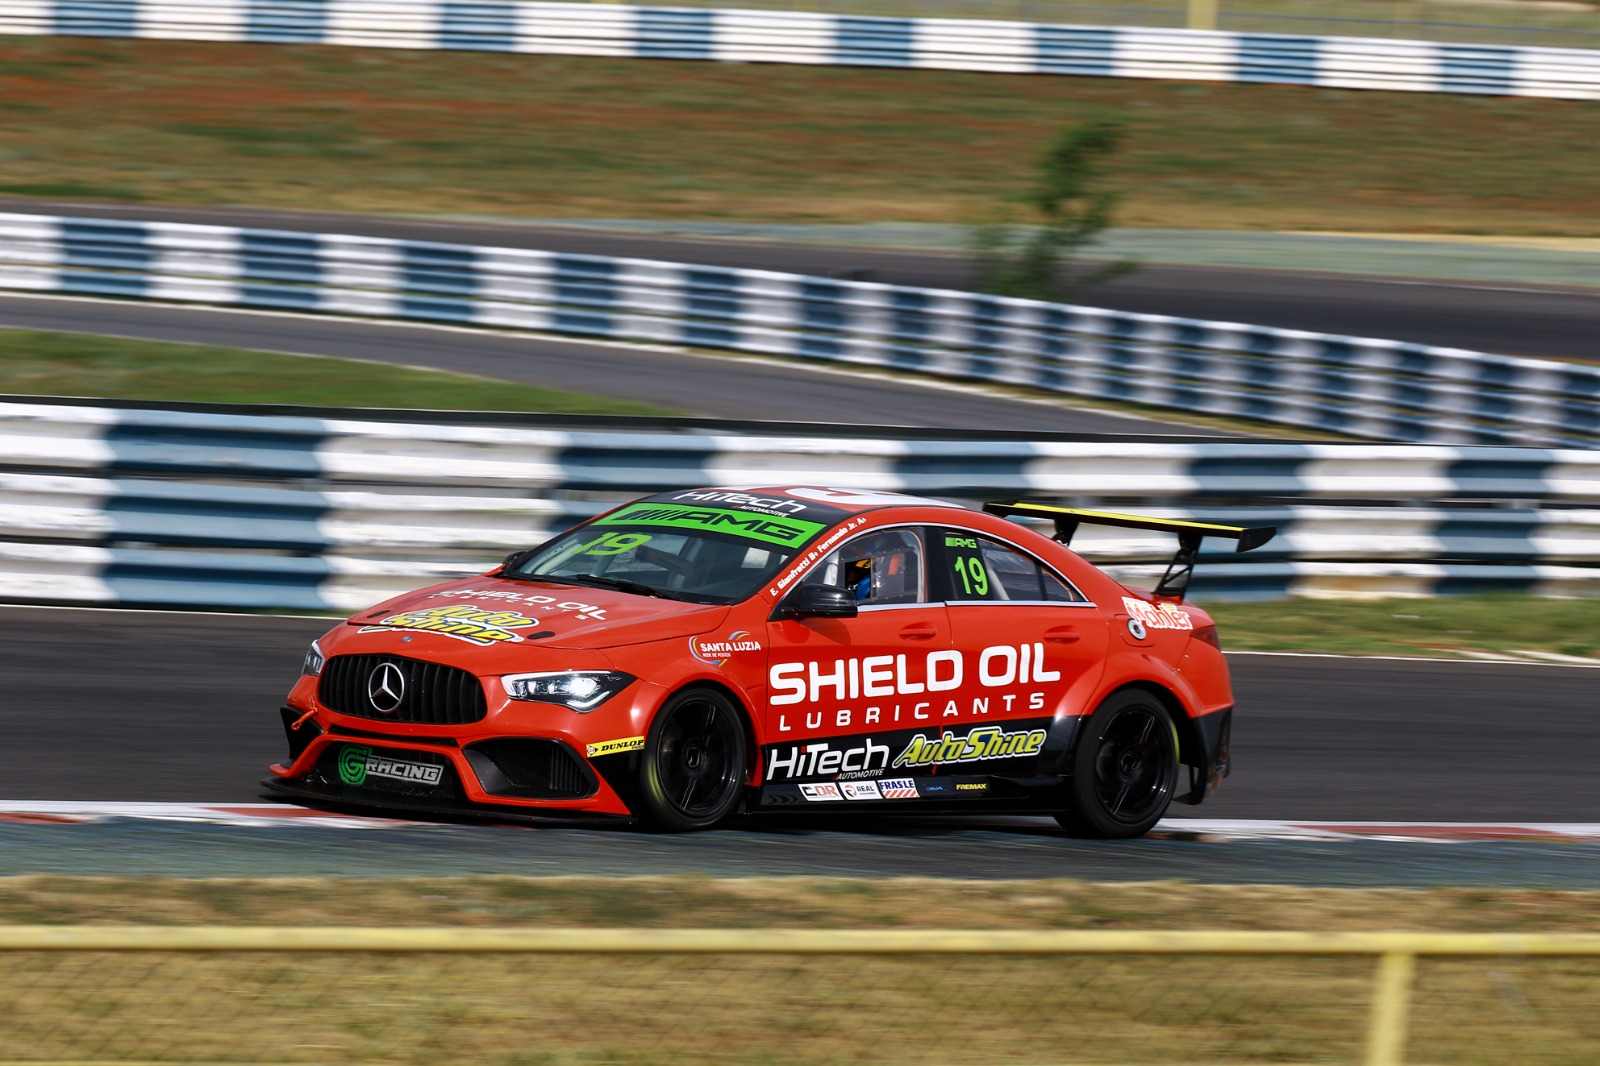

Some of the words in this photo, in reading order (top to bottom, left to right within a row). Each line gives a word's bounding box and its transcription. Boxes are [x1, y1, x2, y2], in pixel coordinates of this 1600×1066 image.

[671, 491, 808, 513] HiTech
[575, 531, 653, 556] 19
[955, 556, 989, 596] 19
[558, 601, 609, 621] OIL
[700, 642, 732, 652] SANTA
[733, 641, 761, 651] LUZIA
[769, 649, 964, 706] SHIELD
[978, 642, 1061, 687] OIL
[779, 692, 1045, 731] LUBRICANTS
[601, 739, 644, 752] DUNLOP
[893, 727, 1047, 769] AutoShine
[766, 738, 890, 781] HiTech
[836, 768, 885, 780] AUTOMOTIVE
[856, 785, 875, 793] REAL
[879, 780, 915, 791] FRASLE
